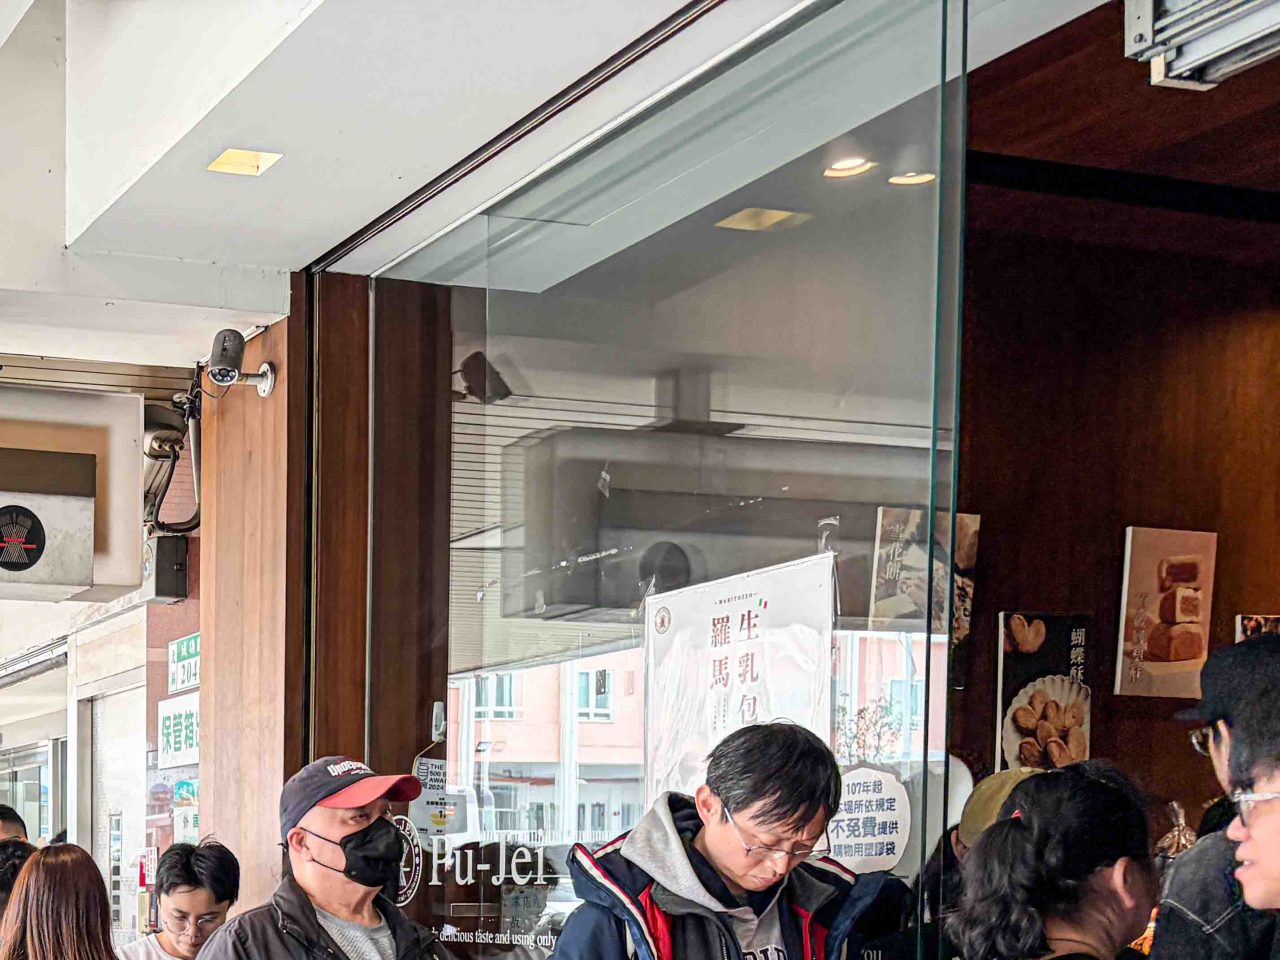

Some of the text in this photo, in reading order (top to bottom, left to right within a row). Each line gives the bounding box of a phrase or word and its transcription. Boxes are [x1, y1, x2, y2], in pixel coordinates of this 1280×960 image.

[710, 614, 731, 690] 羅馬
[738, 609, 760, 725] 生乳包
[846, 780, 883, 796] 107年起
[830, 816, 899, 839] 不免費提供
[428, 832, 548, 887] Pu-Jei
[832, 841, 896, 858] 購物用塑膠袋
[475, 928, 494, 944] taste
[494, 930, 511, 945] and
[511, 931, 535, 949] using
[536, 931, 558, 950] only
